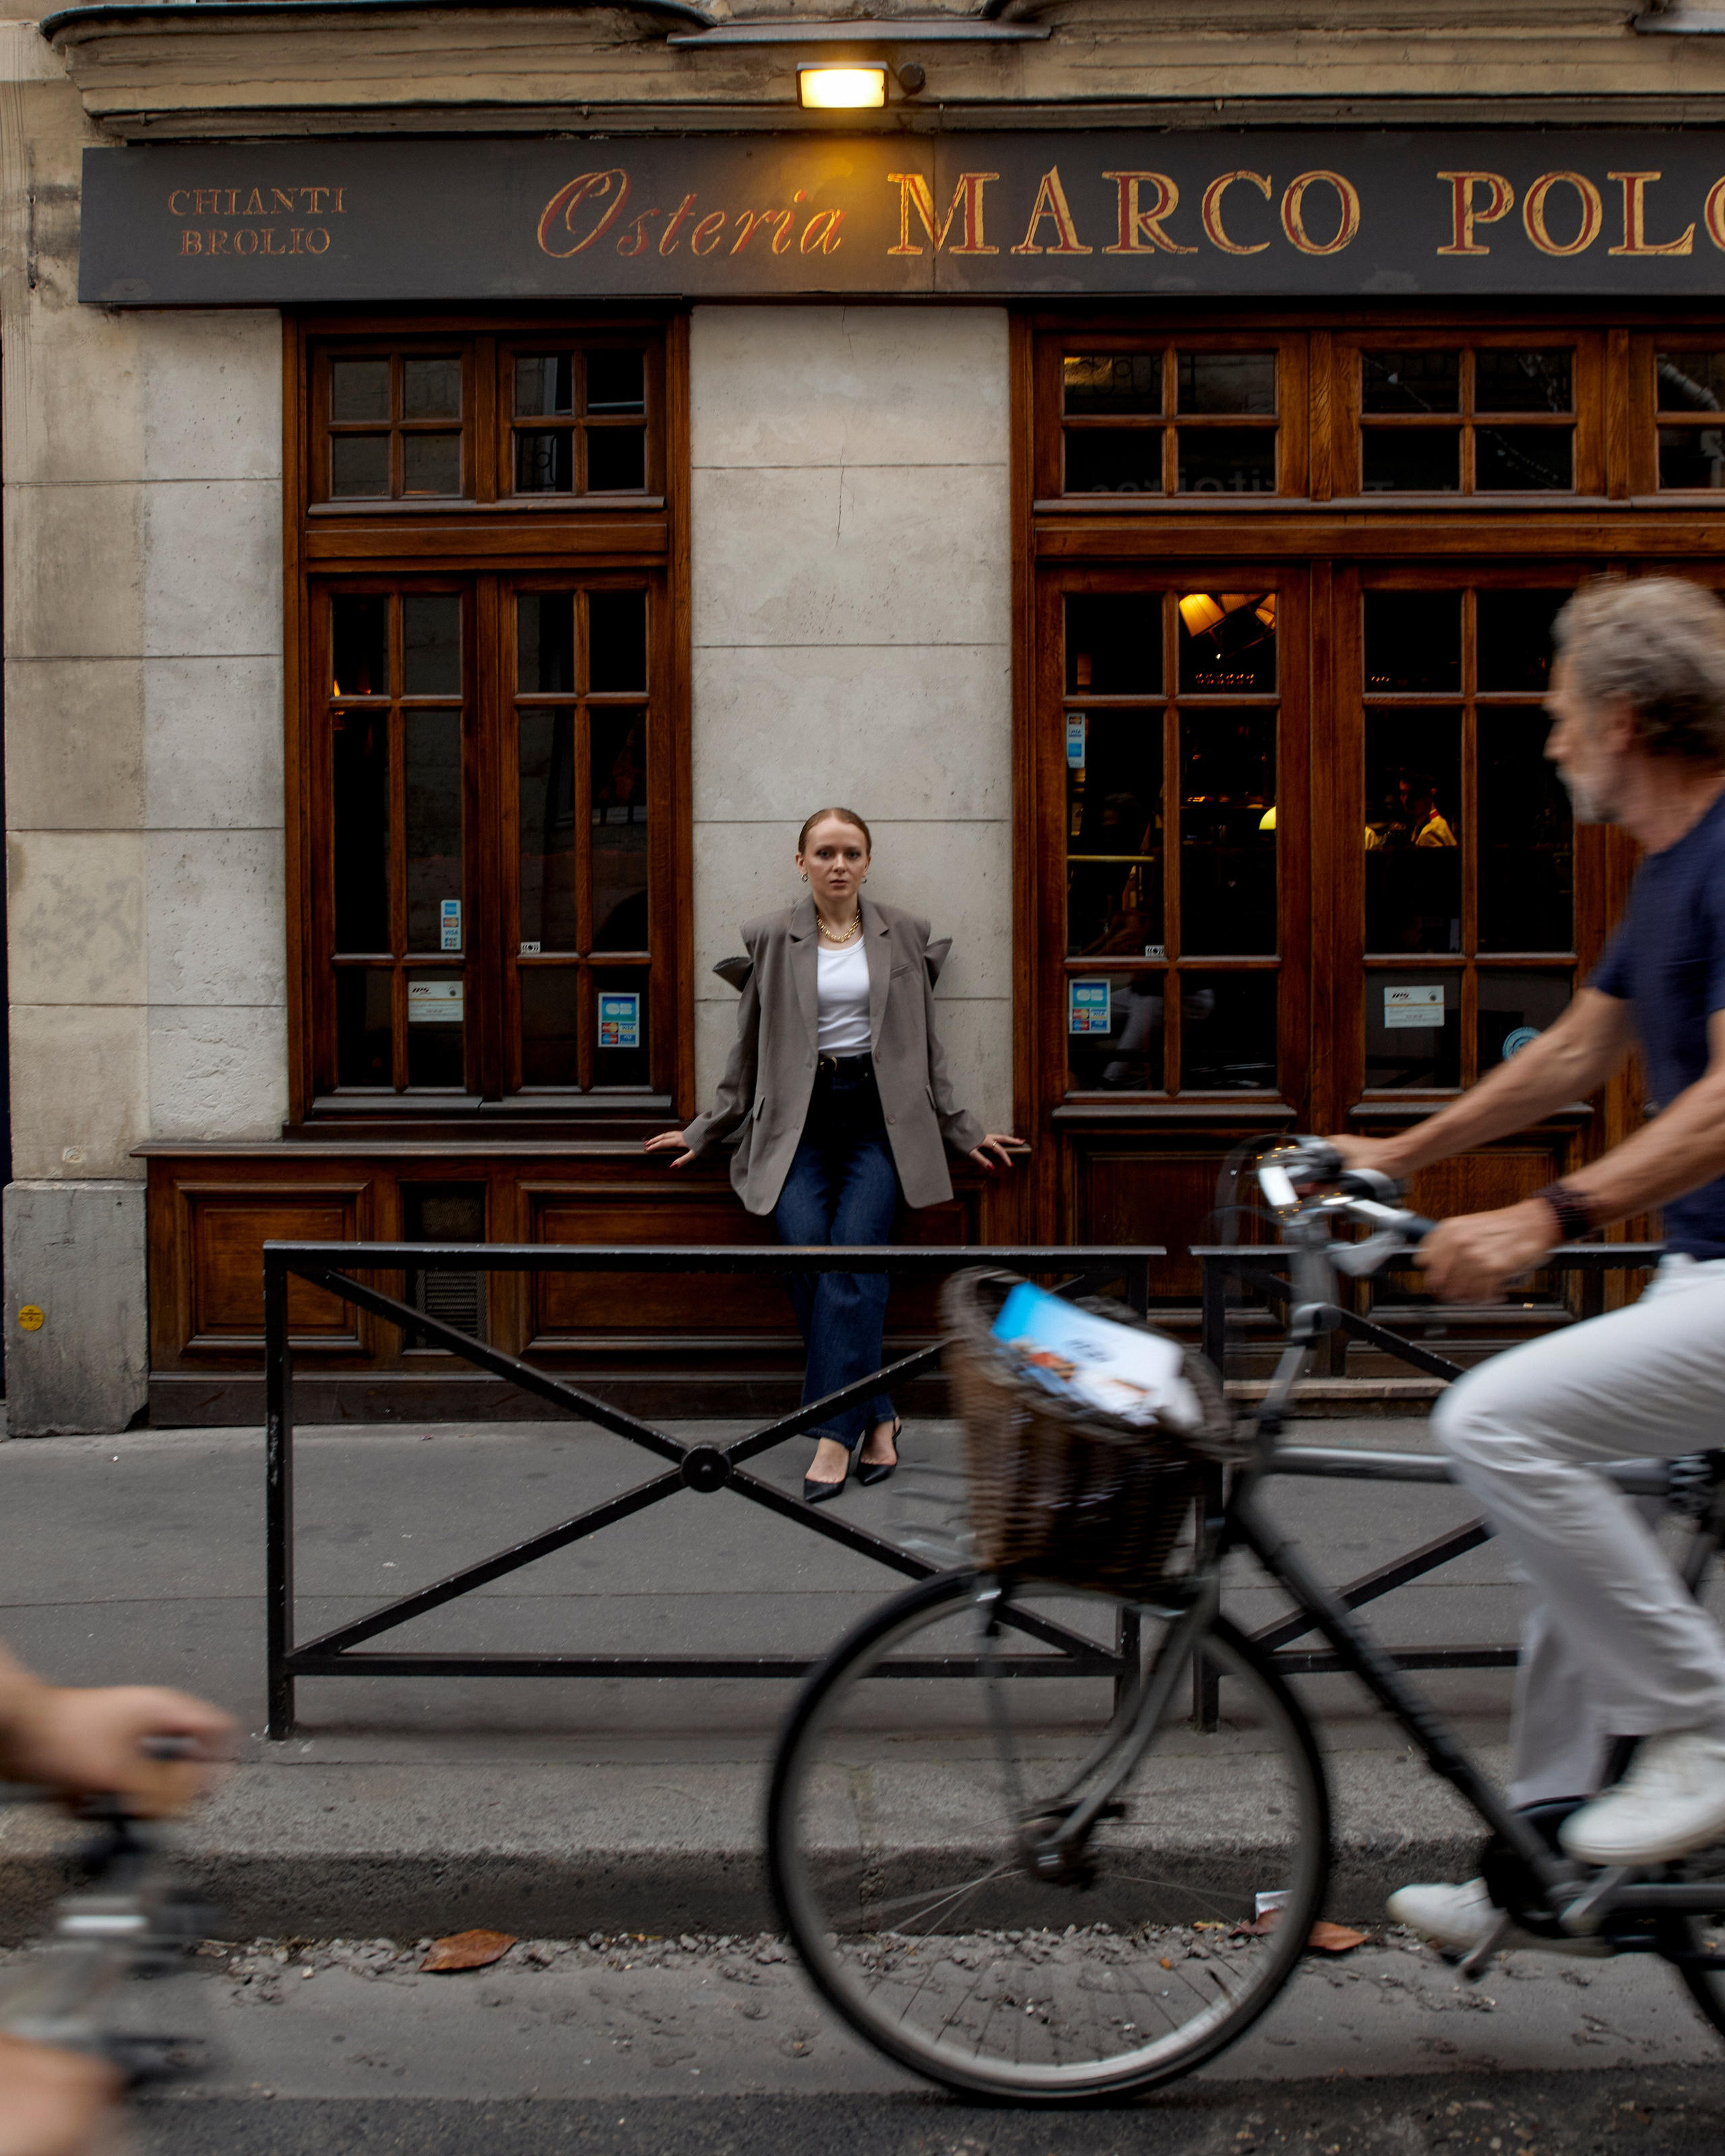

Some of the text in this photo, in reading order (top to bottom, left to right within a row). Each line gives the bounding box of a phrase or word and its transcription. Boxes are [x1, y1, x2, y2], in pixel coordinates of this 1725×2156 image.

[168, 187, 348, 216] CHIANTI
[536, 164, 1725, 258] Osteria MARCO POL
[177, 227, 332, 256] BROLIO
